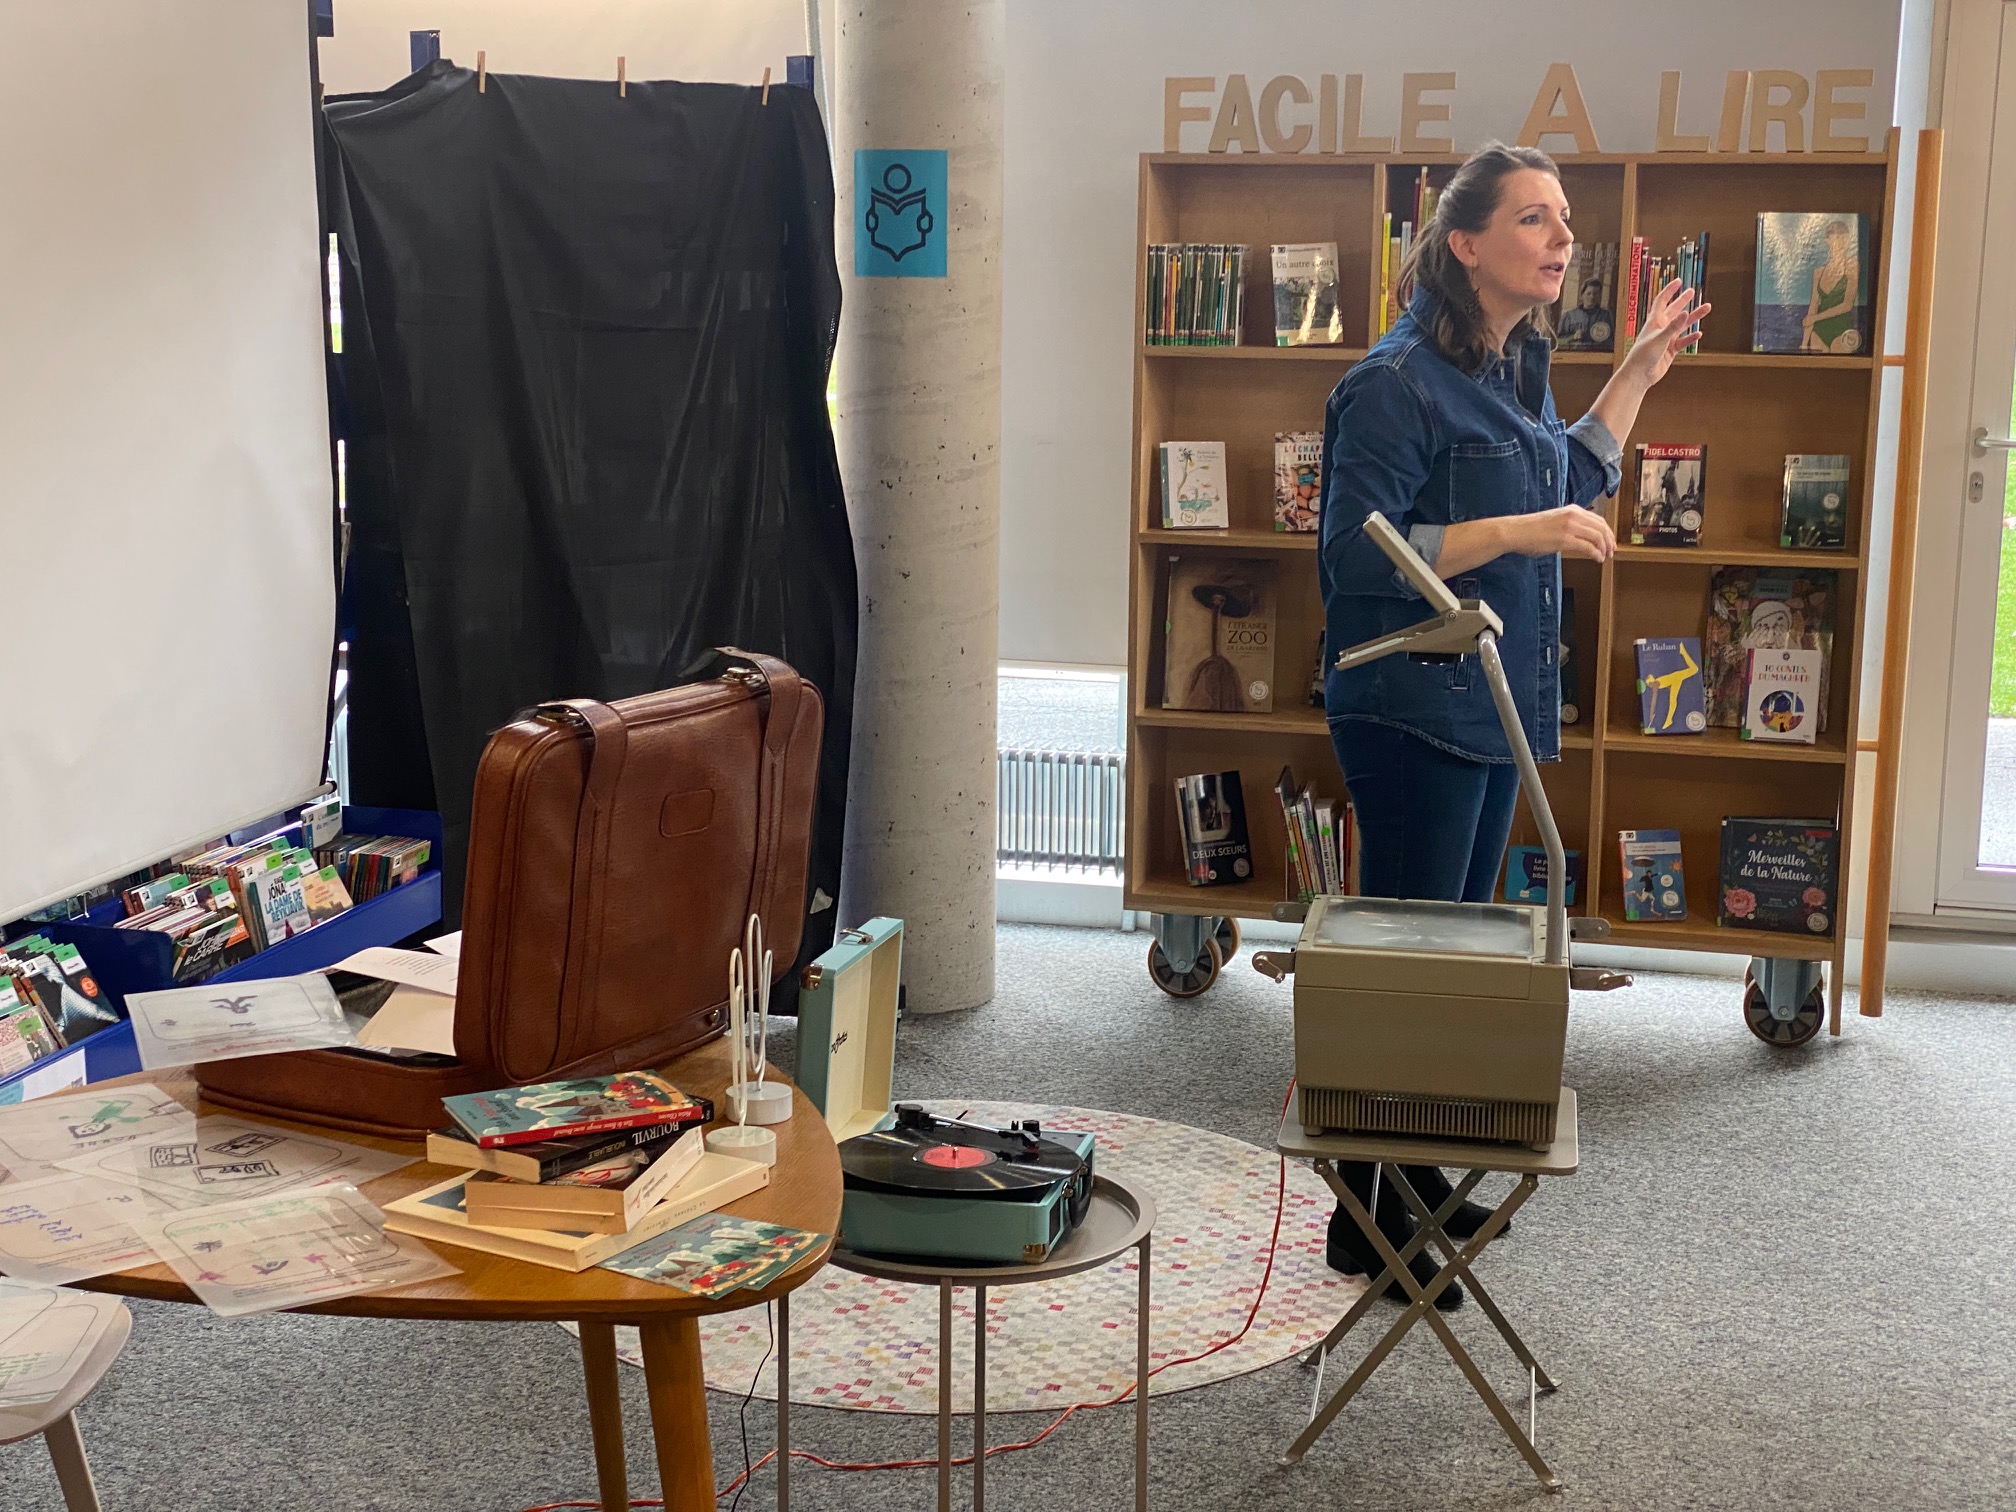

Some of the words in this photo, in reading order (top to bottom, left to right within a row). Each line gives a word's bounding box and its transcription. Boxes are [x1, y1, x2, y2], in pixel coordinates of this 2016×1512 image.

[1163, 71, 1458, 154] FACILE
[1514, 62, 1601, 154] A
[1655, 68, 1875, 153] LIRE
[1284, 443, 1320, 453] L'ÉCHAP
[1643, 447, 1667, 456] FIDEL
[1667, 447, 1701, 457] CASTRO
[1227, 630, 1268, 645] ZOO
[1192, 848, 1217, 860] DEUX
[1747, 849, 1807, 868] Merveilles
[1740, 864, 1756, 877] de
[1756, 866, 1770, 879] la
[1770, 866, 1813, 882] Nature
[631, 1120, 680, 1146] BOURVIL
